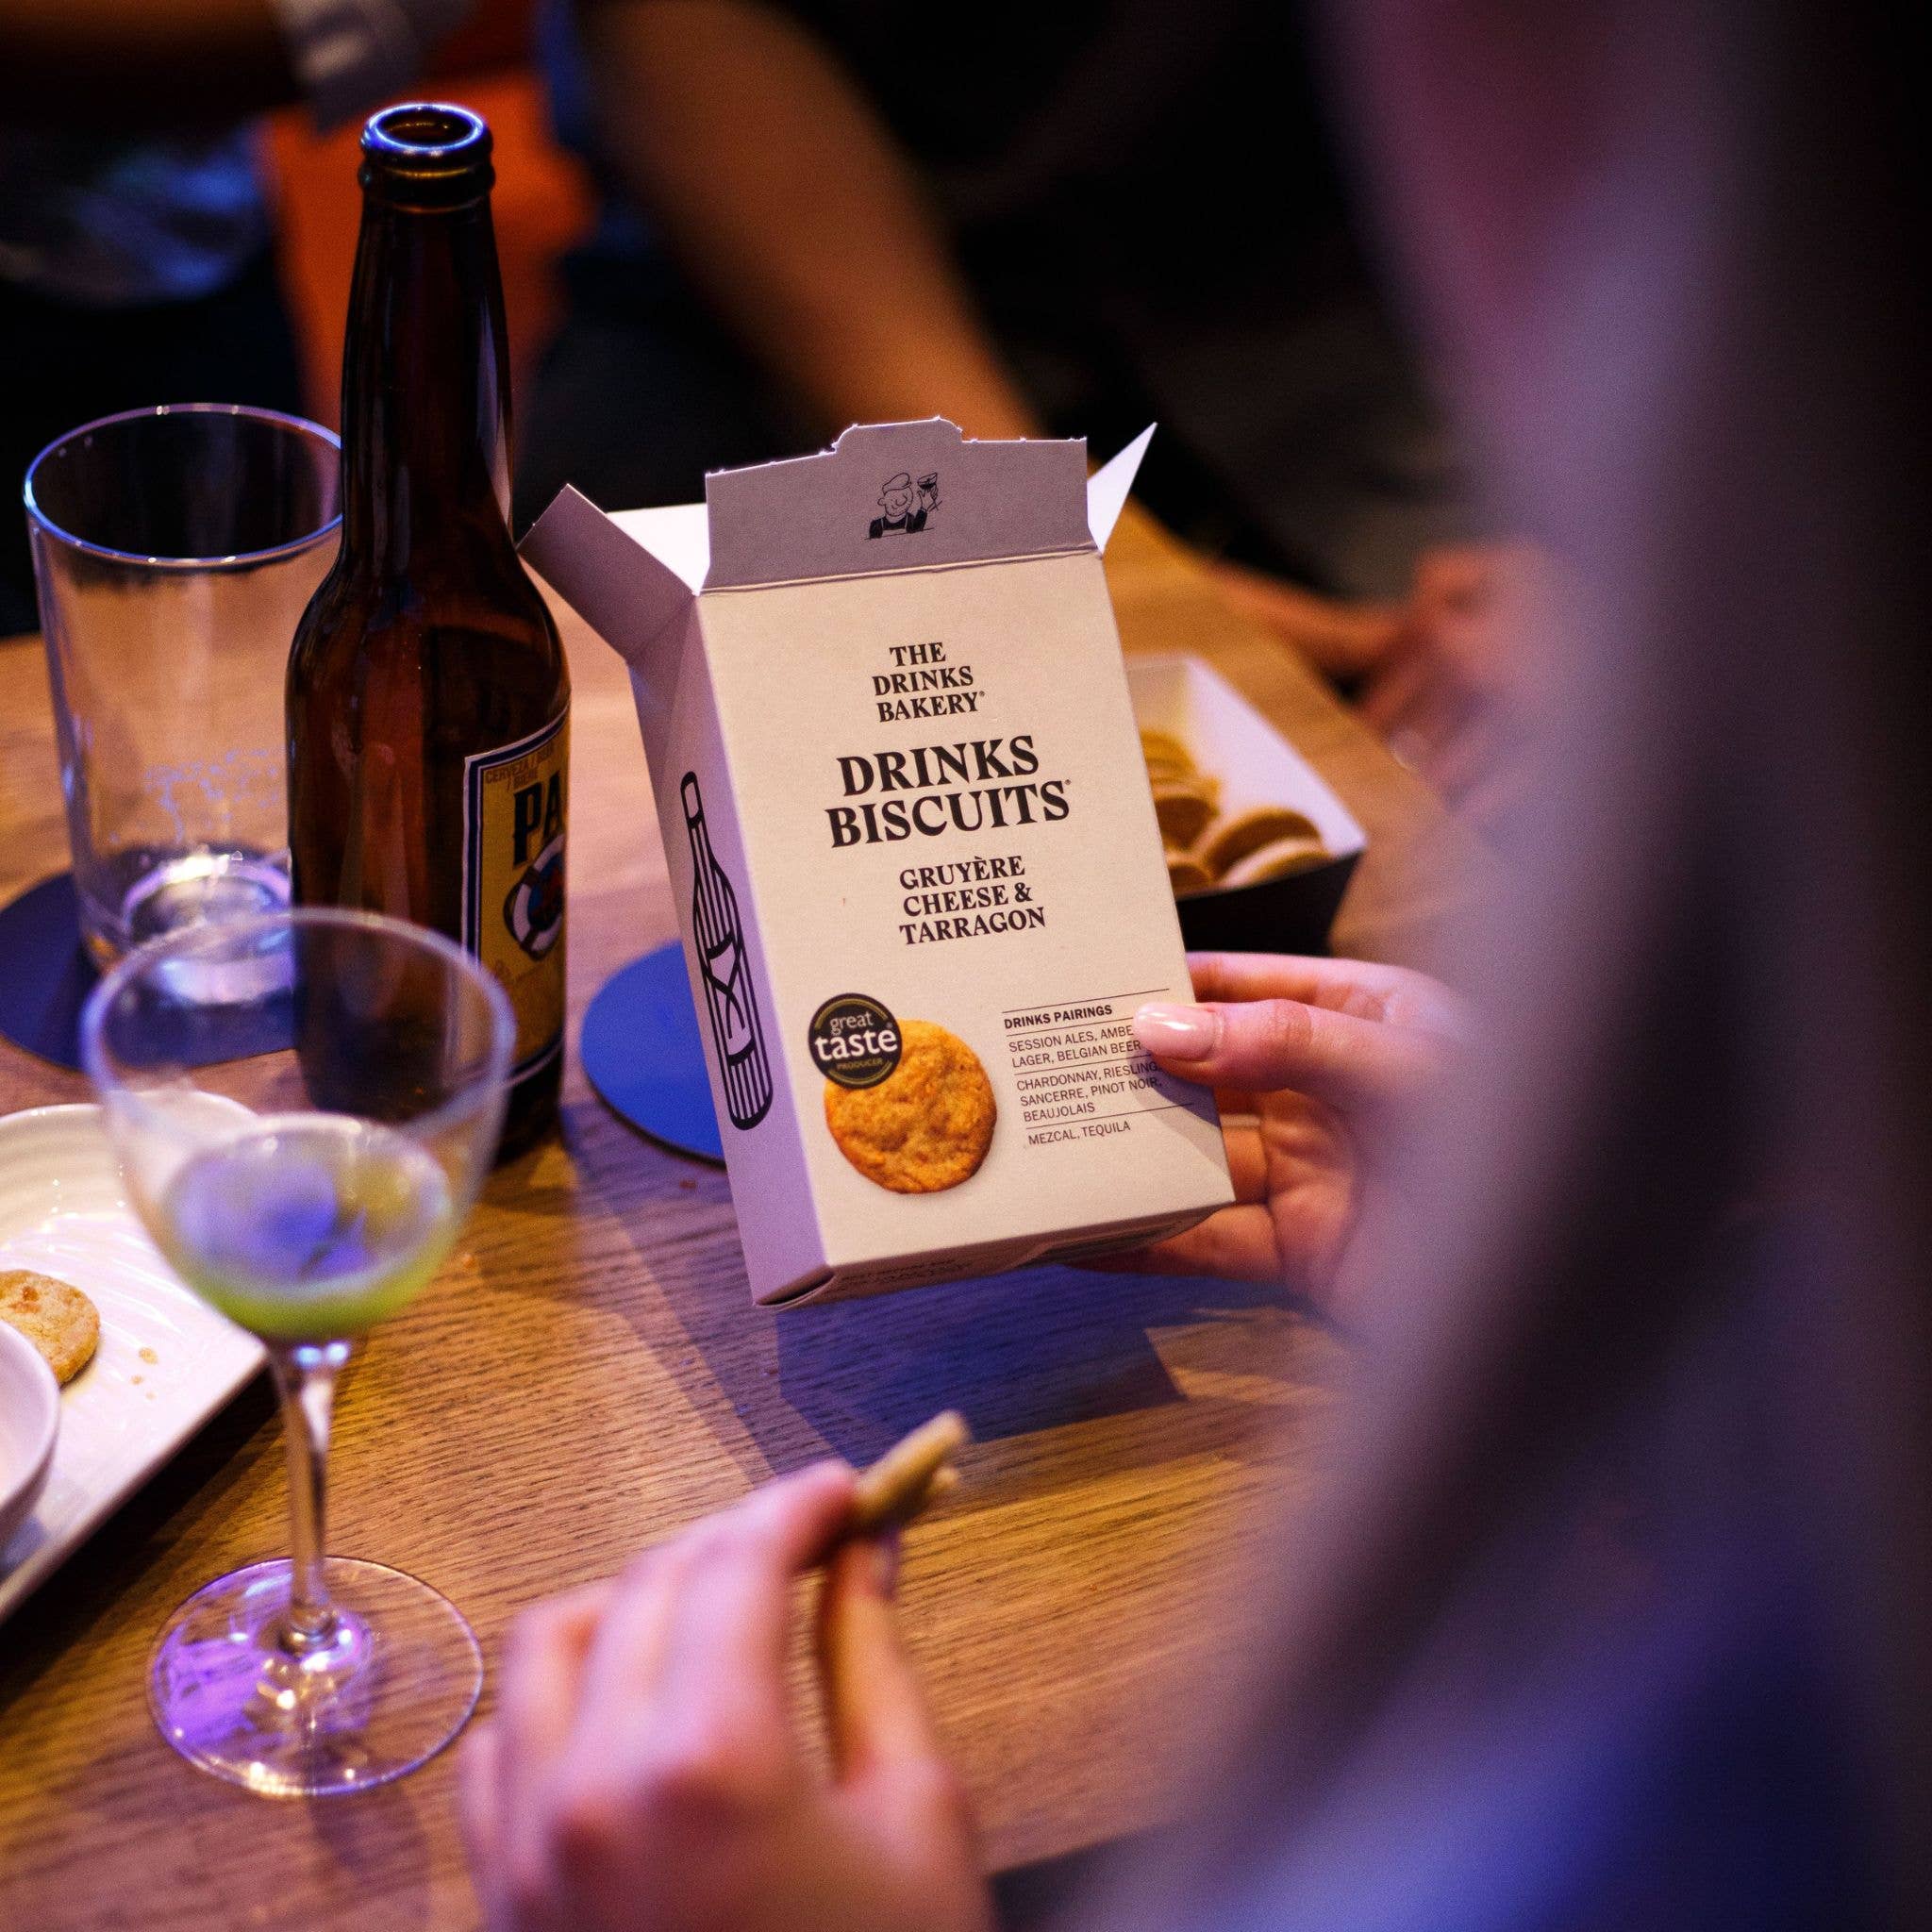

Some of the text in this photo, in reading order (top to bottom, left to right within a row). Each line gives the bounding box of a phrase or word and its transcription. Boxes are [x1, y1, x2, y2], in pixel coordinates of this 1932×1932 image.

[890, 641, 946, 667] THE
[872, 666, 974, 695] DRINKS
[836, 735, 1039, 796] DRINKS
[899, 855, 1025, 890] GRUYÈRE
[903, 882, 1033, 917] CHEESE &
[899, 907, 1046, 945] TARRAGON
[830, 1011, 874, 1036] great
[1004, 1005, 1112, 1029] DRINKS PAIRINGS
[815, 1029, 898, 1061] taste
[1008, 1025, 1134, 1053] SESSION ALES, AMBE
[1011, 1040, 1141, 1068] LAGER, BELGIAN BEER
[1017, 1071, 1102, 1091] CHARDONNAY,
[1020, 1088, 1089, 1107] SANCERRE,
[1091, 1081, 1129, 1096] PINOT
[1024, 1102, 1095, 1123] BEAUJOLAIS
[1028, 1121, 1130, 1145] MEZCAL, TEQUILA
